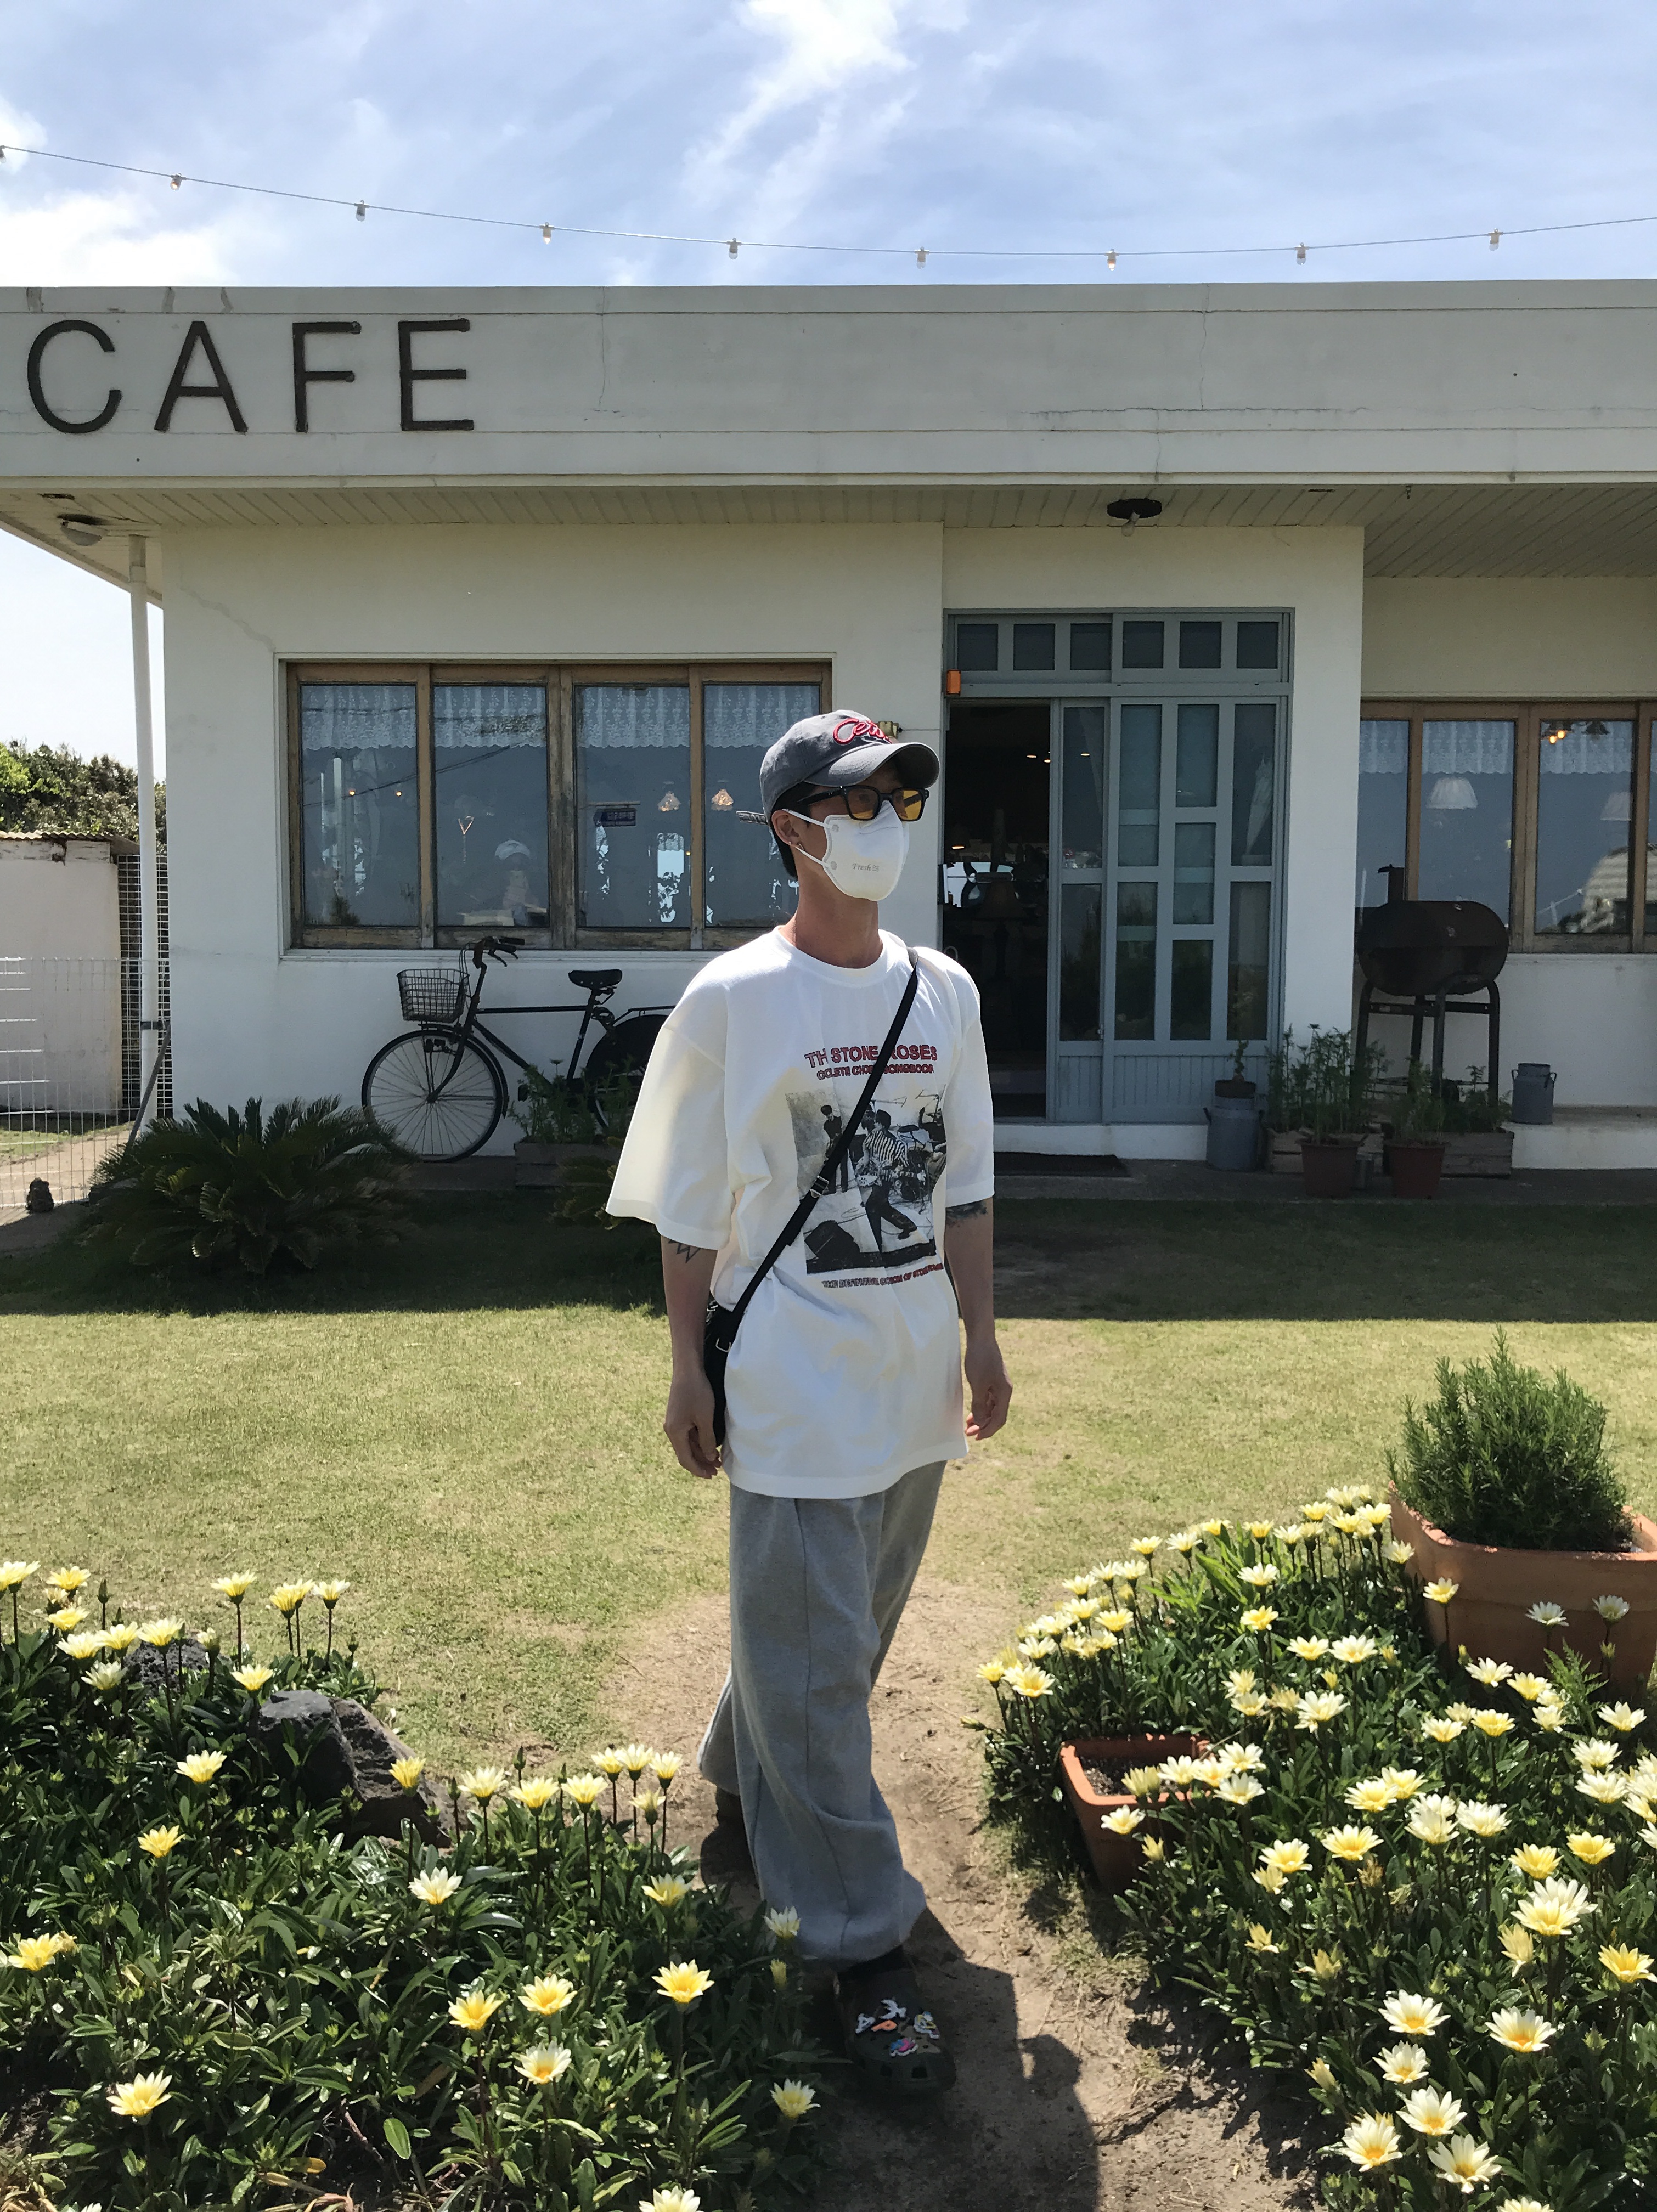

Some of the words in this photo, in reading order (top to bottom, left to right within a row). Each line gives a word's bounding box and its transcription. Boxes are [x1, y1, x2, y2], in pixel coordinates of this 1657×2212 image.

[26, 318, 475, 434] CAFE
[804, 1048, 828, 1068] TH
[830, 1046, 878, 1063] STONE
